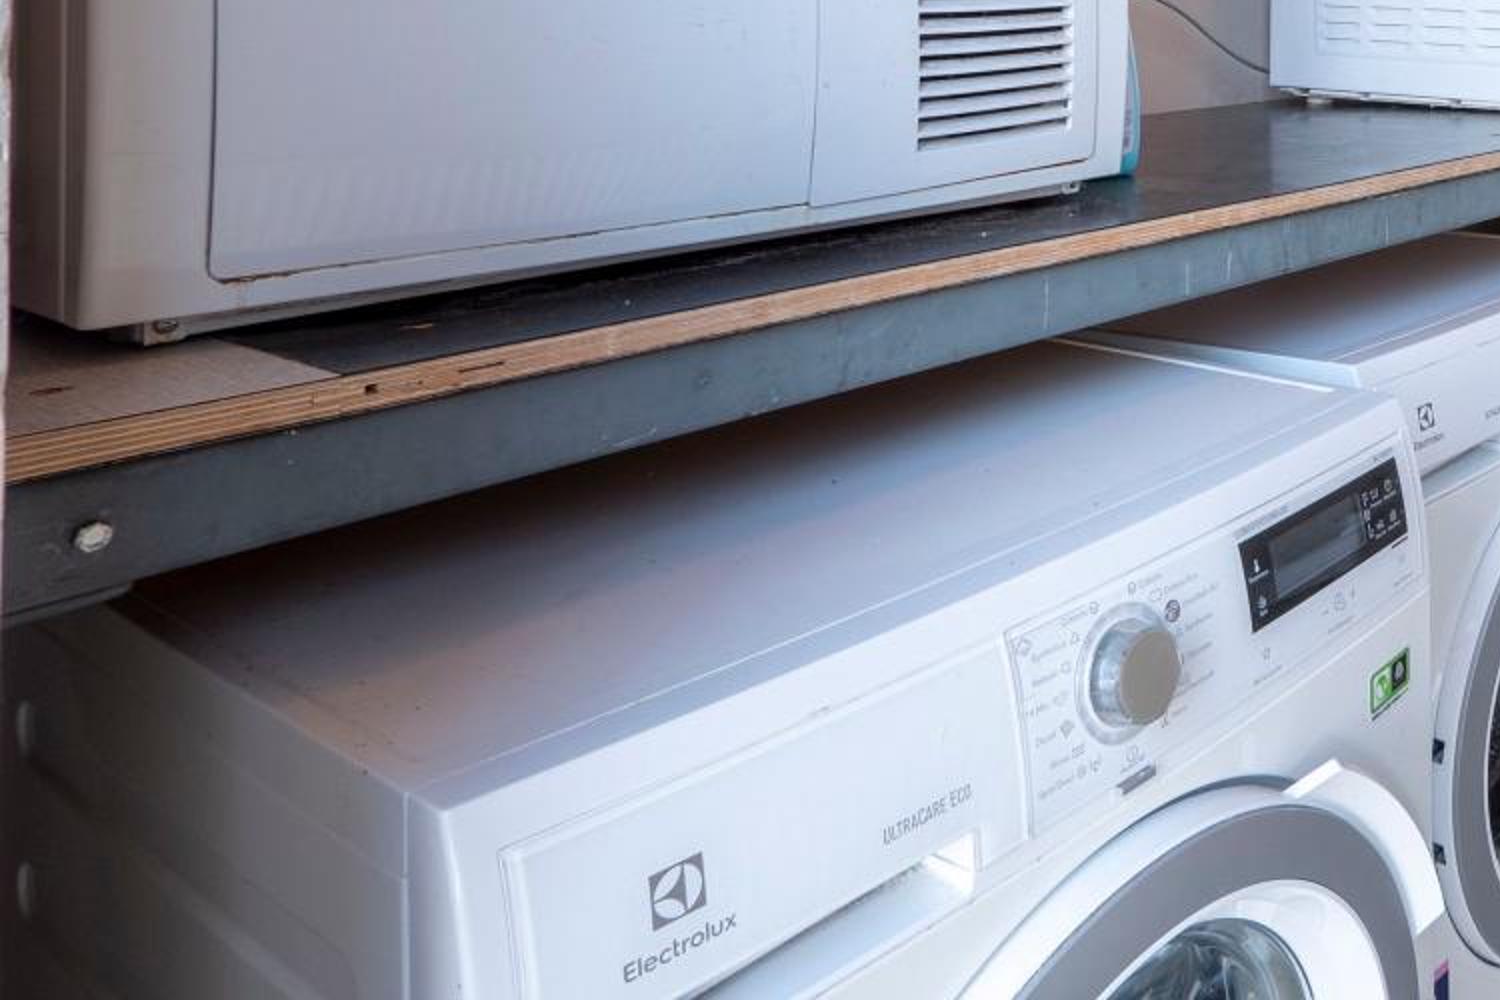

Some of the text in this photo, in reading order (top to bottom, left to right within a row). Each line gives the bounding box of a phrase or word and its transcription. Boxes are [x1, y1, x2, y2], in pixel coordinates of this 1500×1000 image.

[883, 783, 972, 845] ULTRACARE ECO
[623, 913, 736, 983] Electrolux
